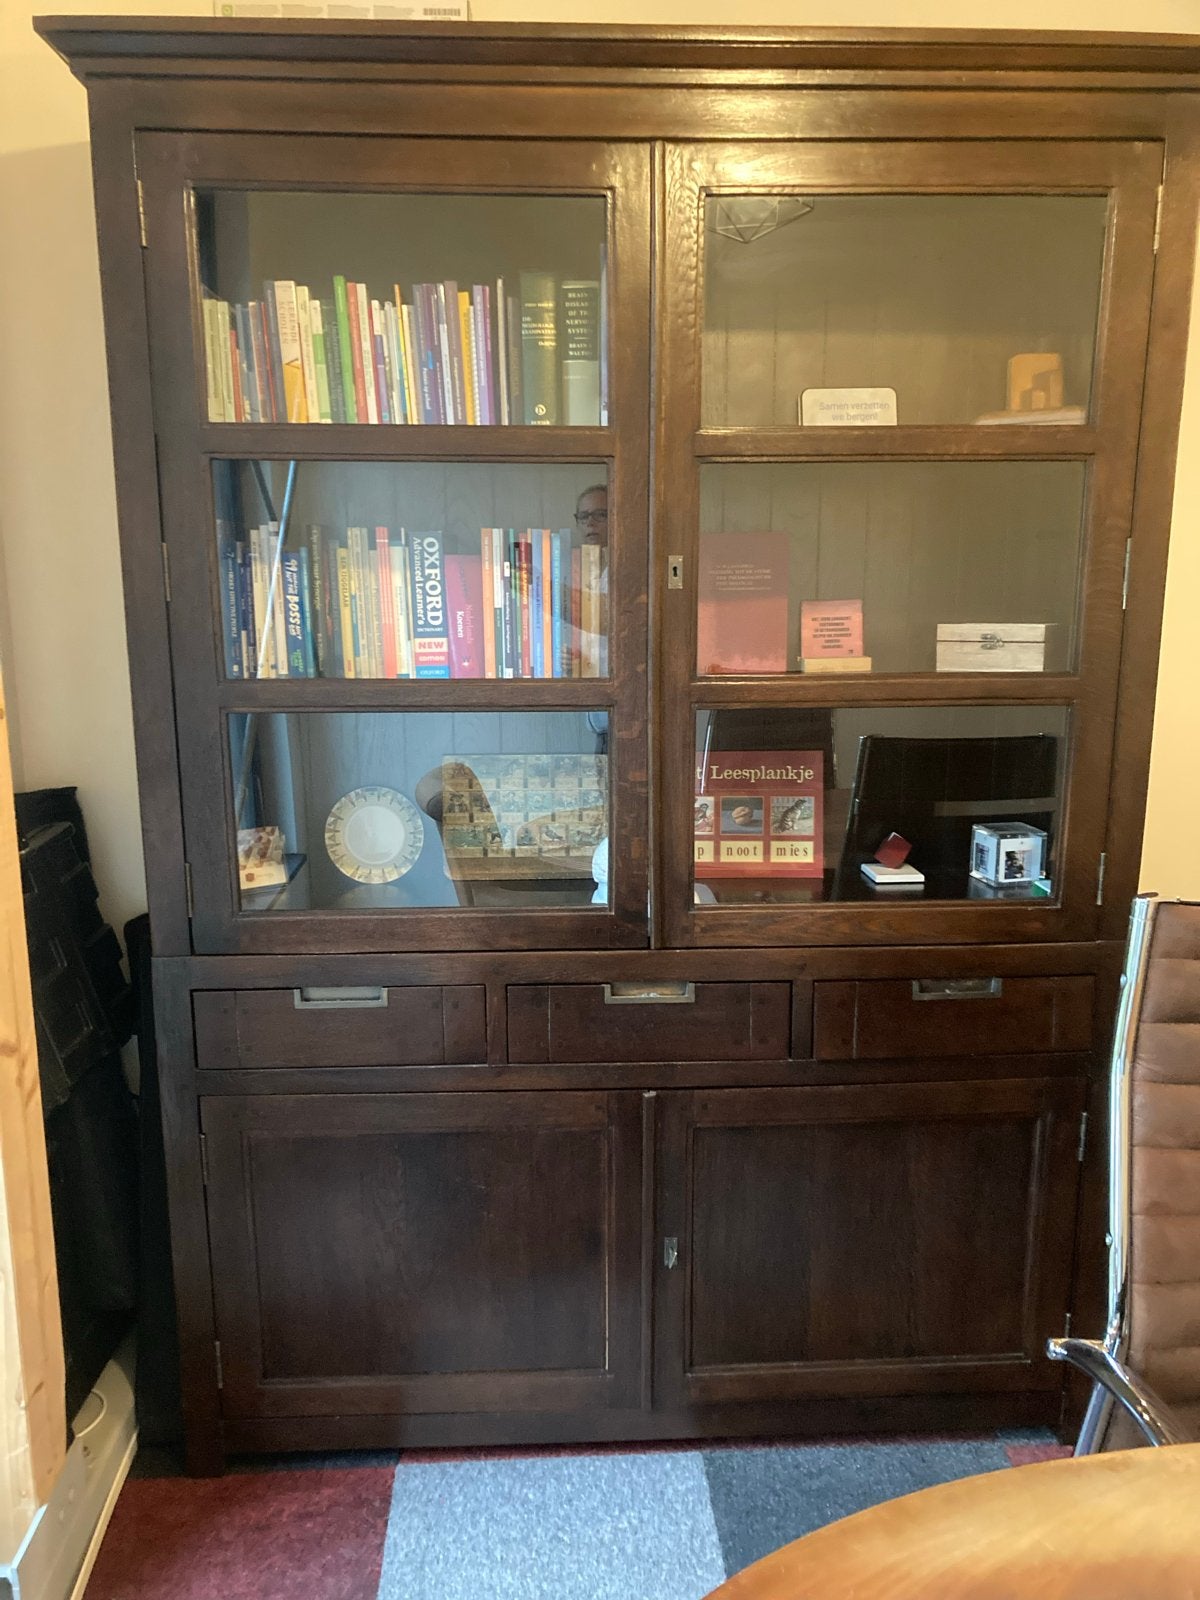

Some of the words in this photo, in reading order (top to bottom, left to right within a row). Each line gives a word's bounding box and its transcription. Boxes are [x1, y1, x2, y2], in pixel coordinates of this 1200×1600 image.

[819, 402, 849, 411] Samen
[851, 401, 890, 411] verzetten
[413, 537, 424, 581] Advanced
[423, 537, 444, 627] OXFORD
[286, 595, 301, 625] BOSS
[415, 581, 426, 625] Learner's
[456, 611, 464, 638] Koenen
[418, 641, 444, 650] NEW
[710, 766, 814, 783] Leesplankje
